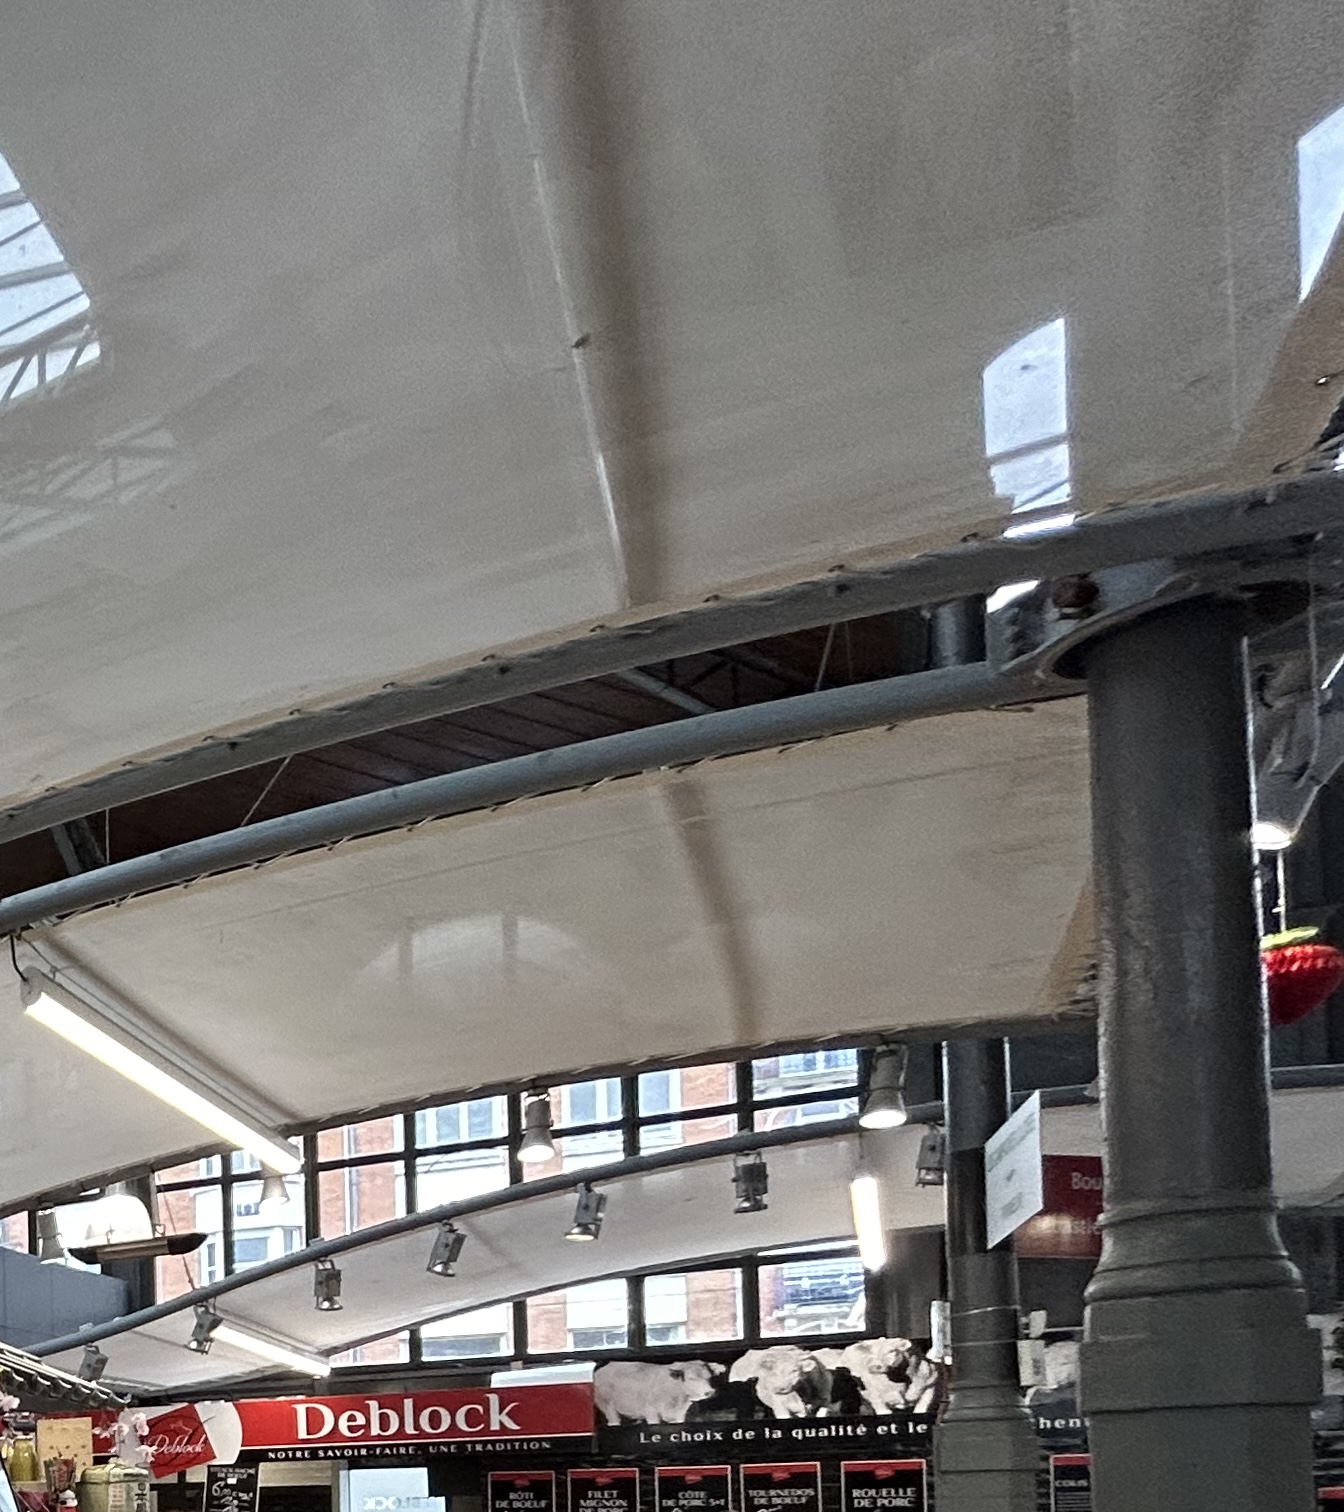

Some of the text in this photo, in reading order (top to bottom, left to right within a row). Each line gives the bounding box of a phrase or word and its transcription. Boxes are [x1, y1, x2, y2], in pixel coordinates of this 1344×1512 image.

[291, 1393, 521, 1440] Deblock
[639, 1421, 929, 1444] Le choix de la qualité et le
[268, 1450, 311, 1460] NOTRE
[428, 1444, 458, 1454] UNE
[466, 1440, 552, 1452] TRADITION
[852, 1487, 917, 1498] ROUELLE
[853, 1497, 914, 1508] DE PORC
